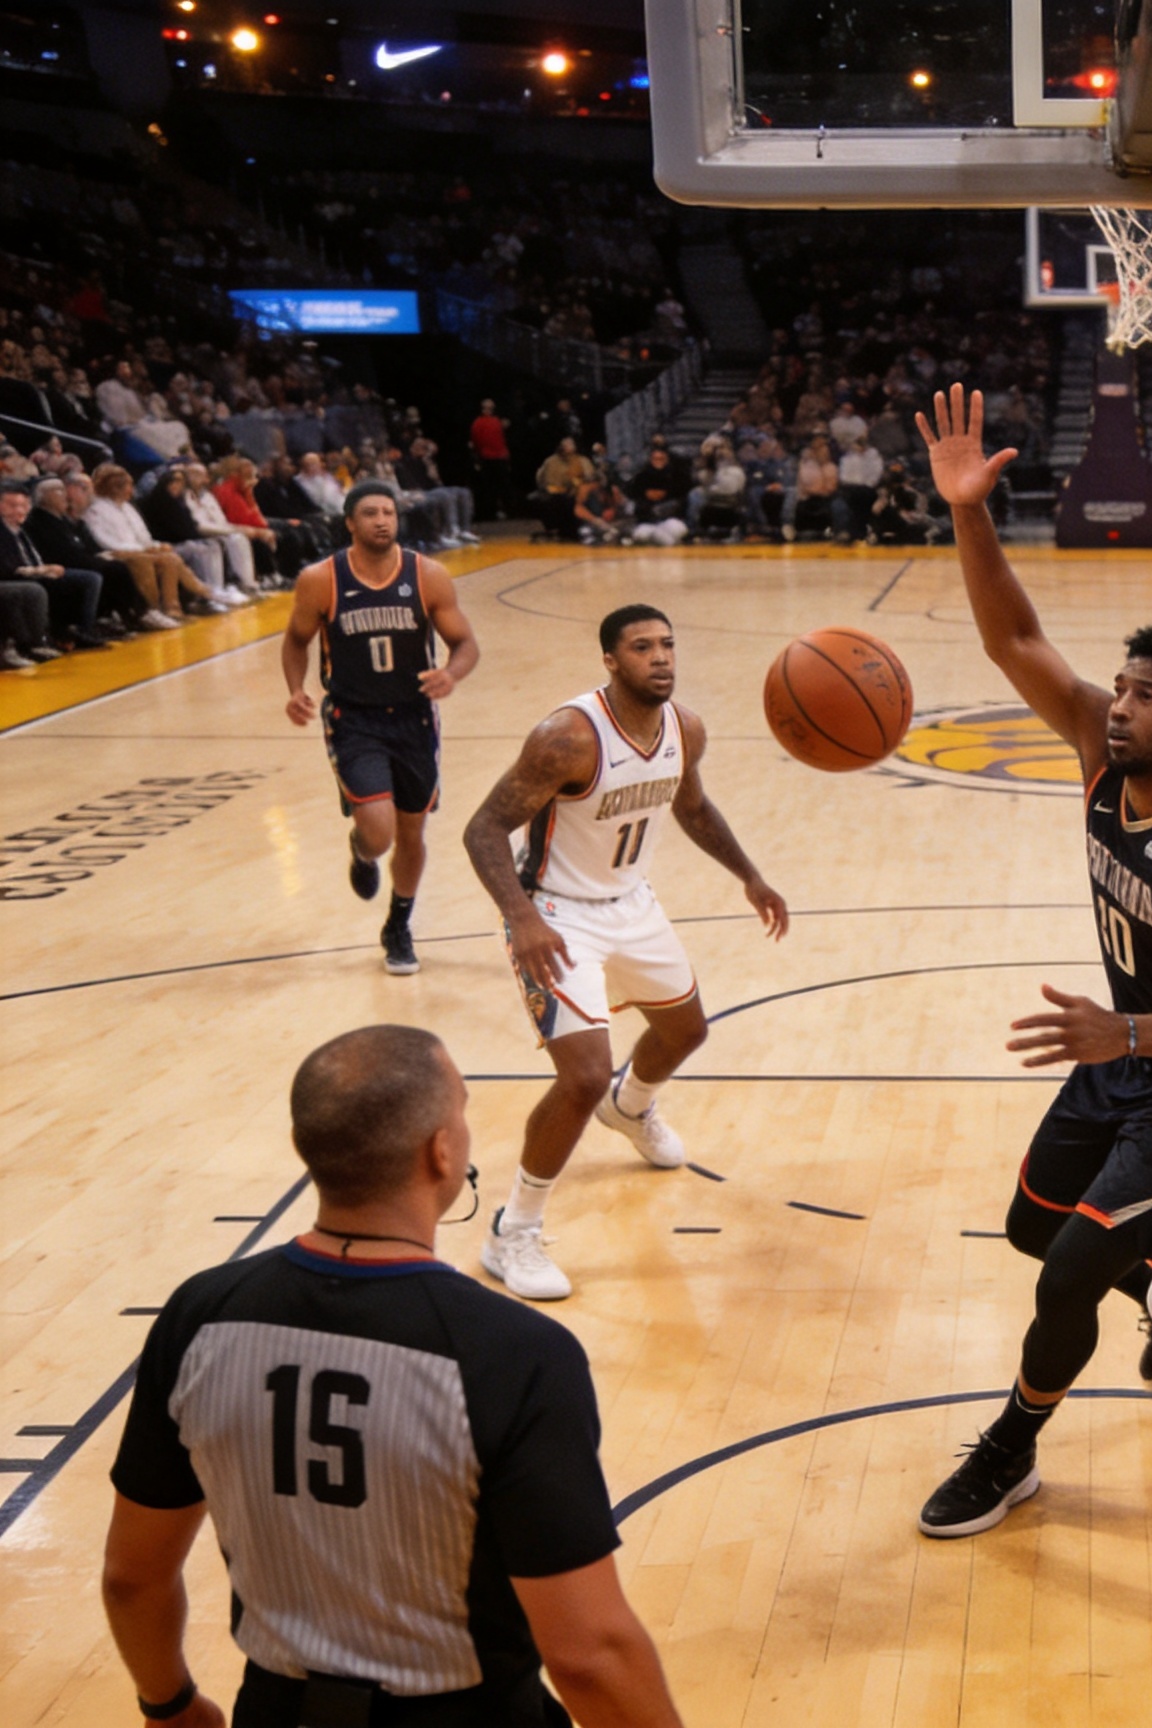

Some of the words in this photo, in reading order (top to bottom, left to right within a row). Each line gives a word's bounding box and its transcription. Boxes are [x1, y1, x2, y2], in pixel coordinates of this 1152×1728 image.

[369, 635, 394, 673] 0
[611, 816, 649, 869] 11
[265, 1363, 371, 1509] 15
